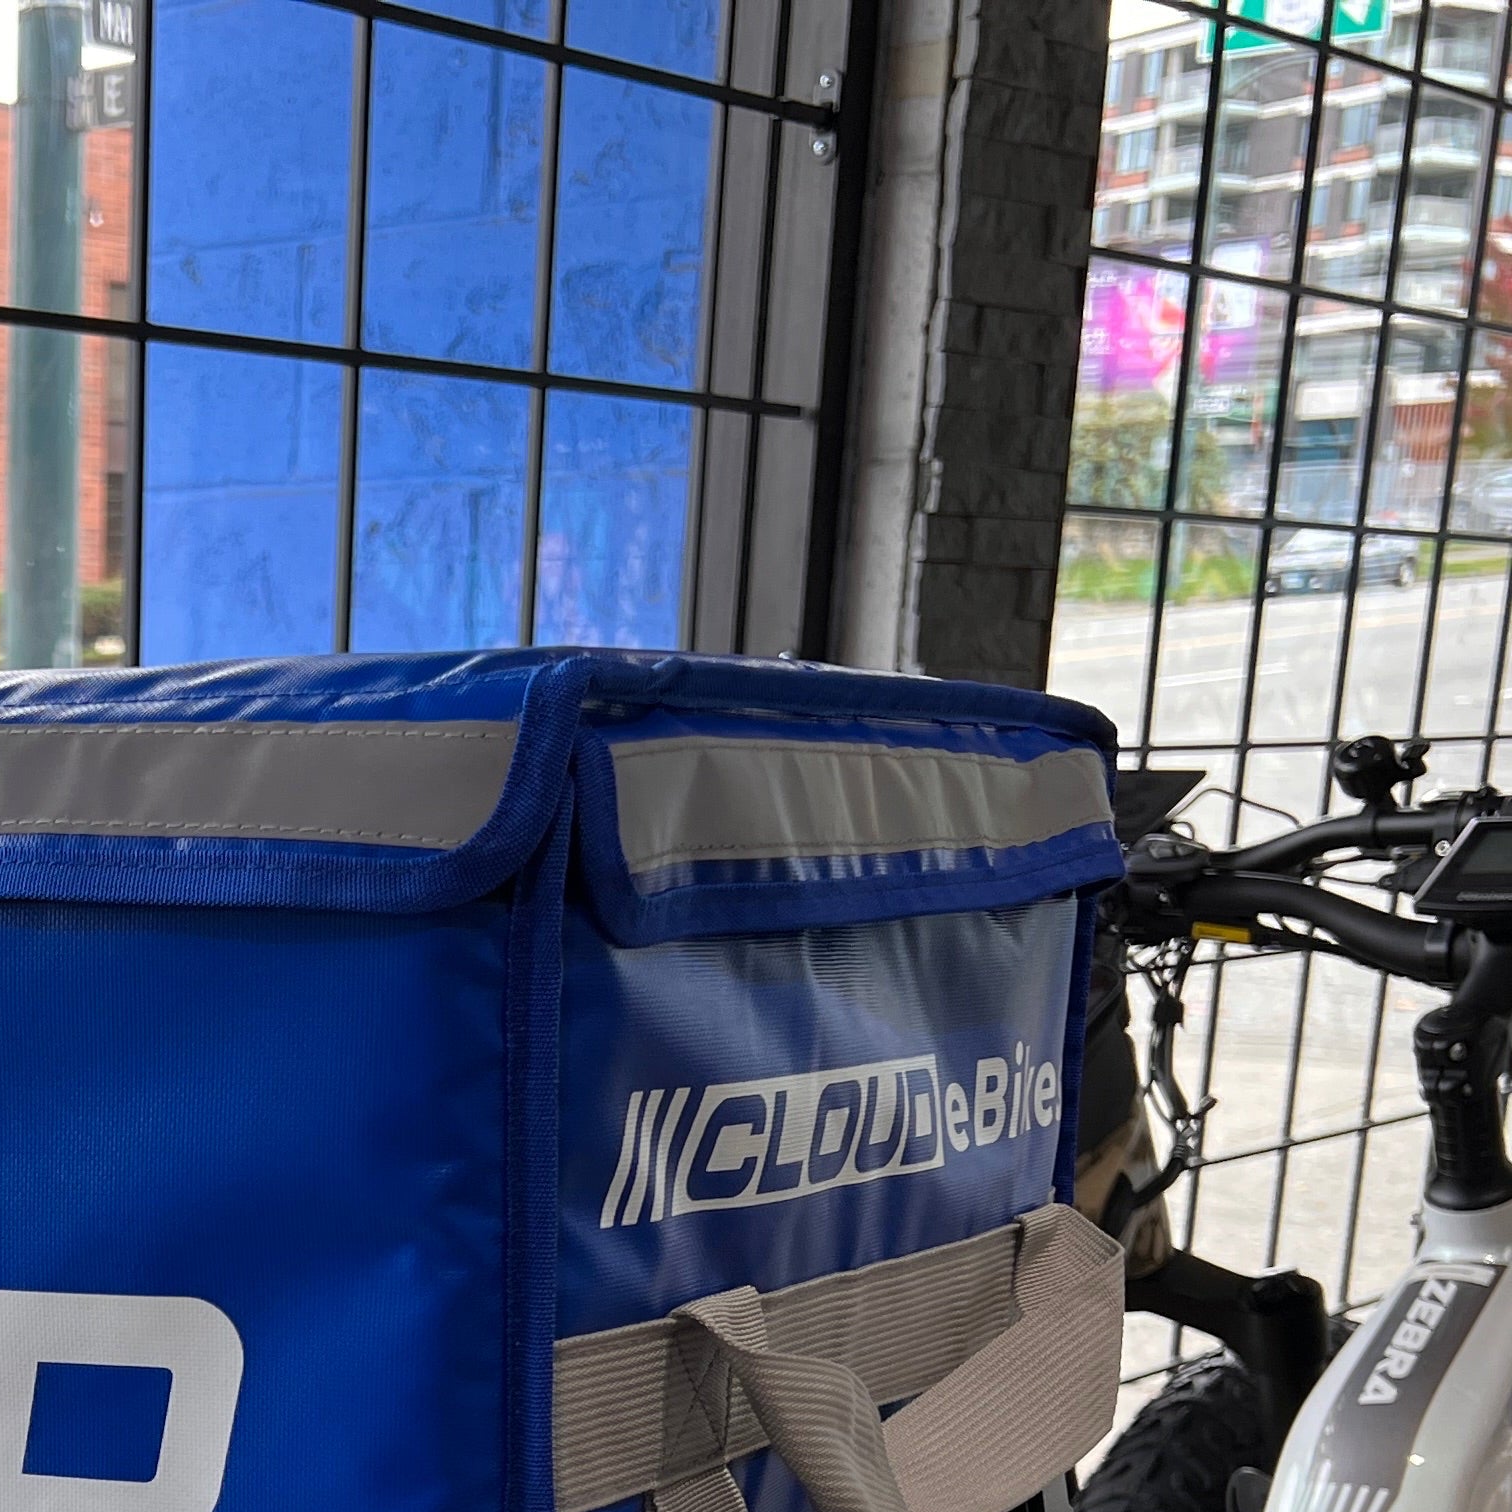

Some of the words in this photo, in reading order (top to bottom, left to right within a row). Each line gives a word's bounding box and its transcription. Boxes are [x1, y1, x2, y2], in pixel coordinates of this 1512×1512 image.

[686, 1068, 941, 1202] CLOUD
[944, 1040, 1062, 1152] eBike
[1358, 1278, 1458, 1406] ZEBRA
